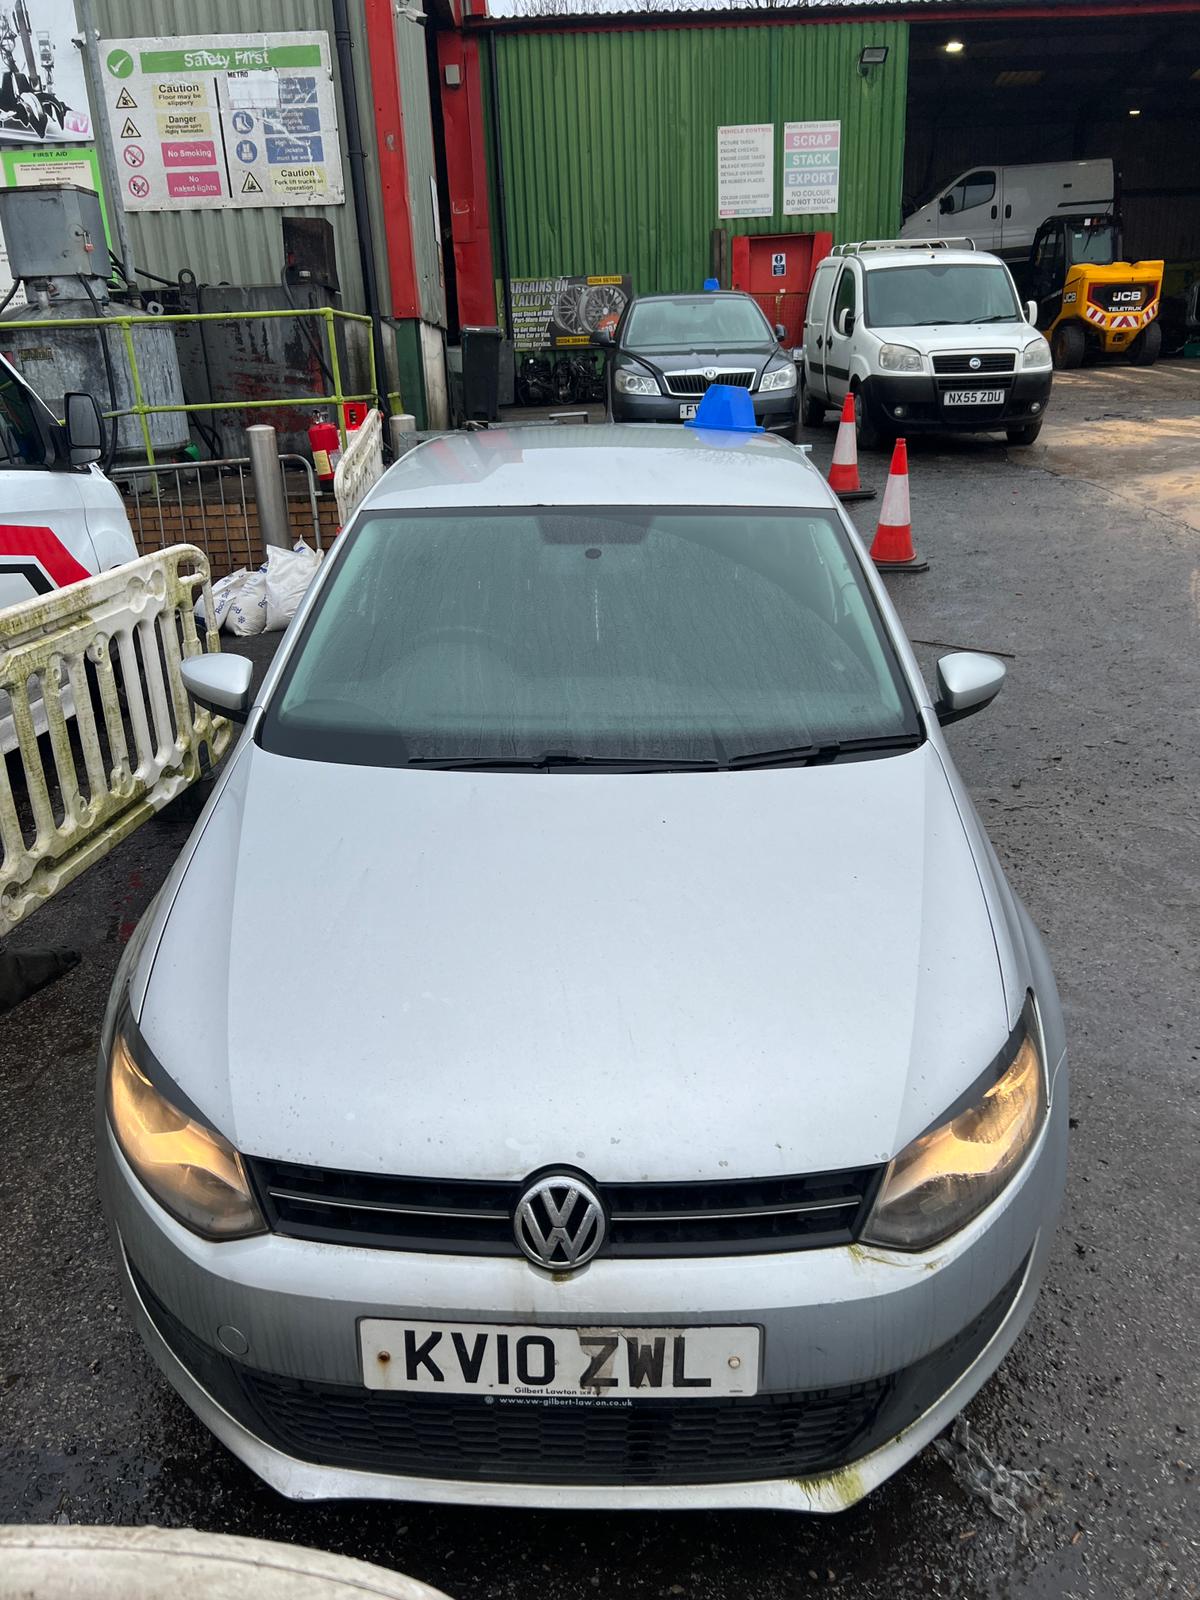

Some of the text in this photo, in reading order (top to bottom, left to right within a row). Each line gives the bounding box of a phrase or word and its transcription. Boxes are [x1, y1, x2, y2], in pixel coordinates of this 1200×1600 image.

[184, 49, 269, 68] Safety First
[159, 84, 200, 93] Caution
[168, 115, 196, 124] Danger
[793, 135, 832, 146] SCRAP
[180, 150, 212, 158] Smoking
[793, 153, 831, 166] STACK
[281, 169, 315, 177] Caution
[788, 172, 834, 184] EXPORT
[197, 184, 217, 192] lights
[511, 279, 569, 293] ARGAINS ON
[519, 293, 559, 306] ALLOY'S!
[1064, 292, 1077, 303] JCB
[1113, 291, 1141, 301] JCB
[949, 391, 1001, 403] NX55 ZDU
[404, 1329, 712, 1388] KV10 ZWL
[514, 1386, 544, 1395] Gilbert
[545, 1387, 577, 1395] Lawton
[499, 1397, 633, 1407] www.vw-gilbert-lawon.co.uk
